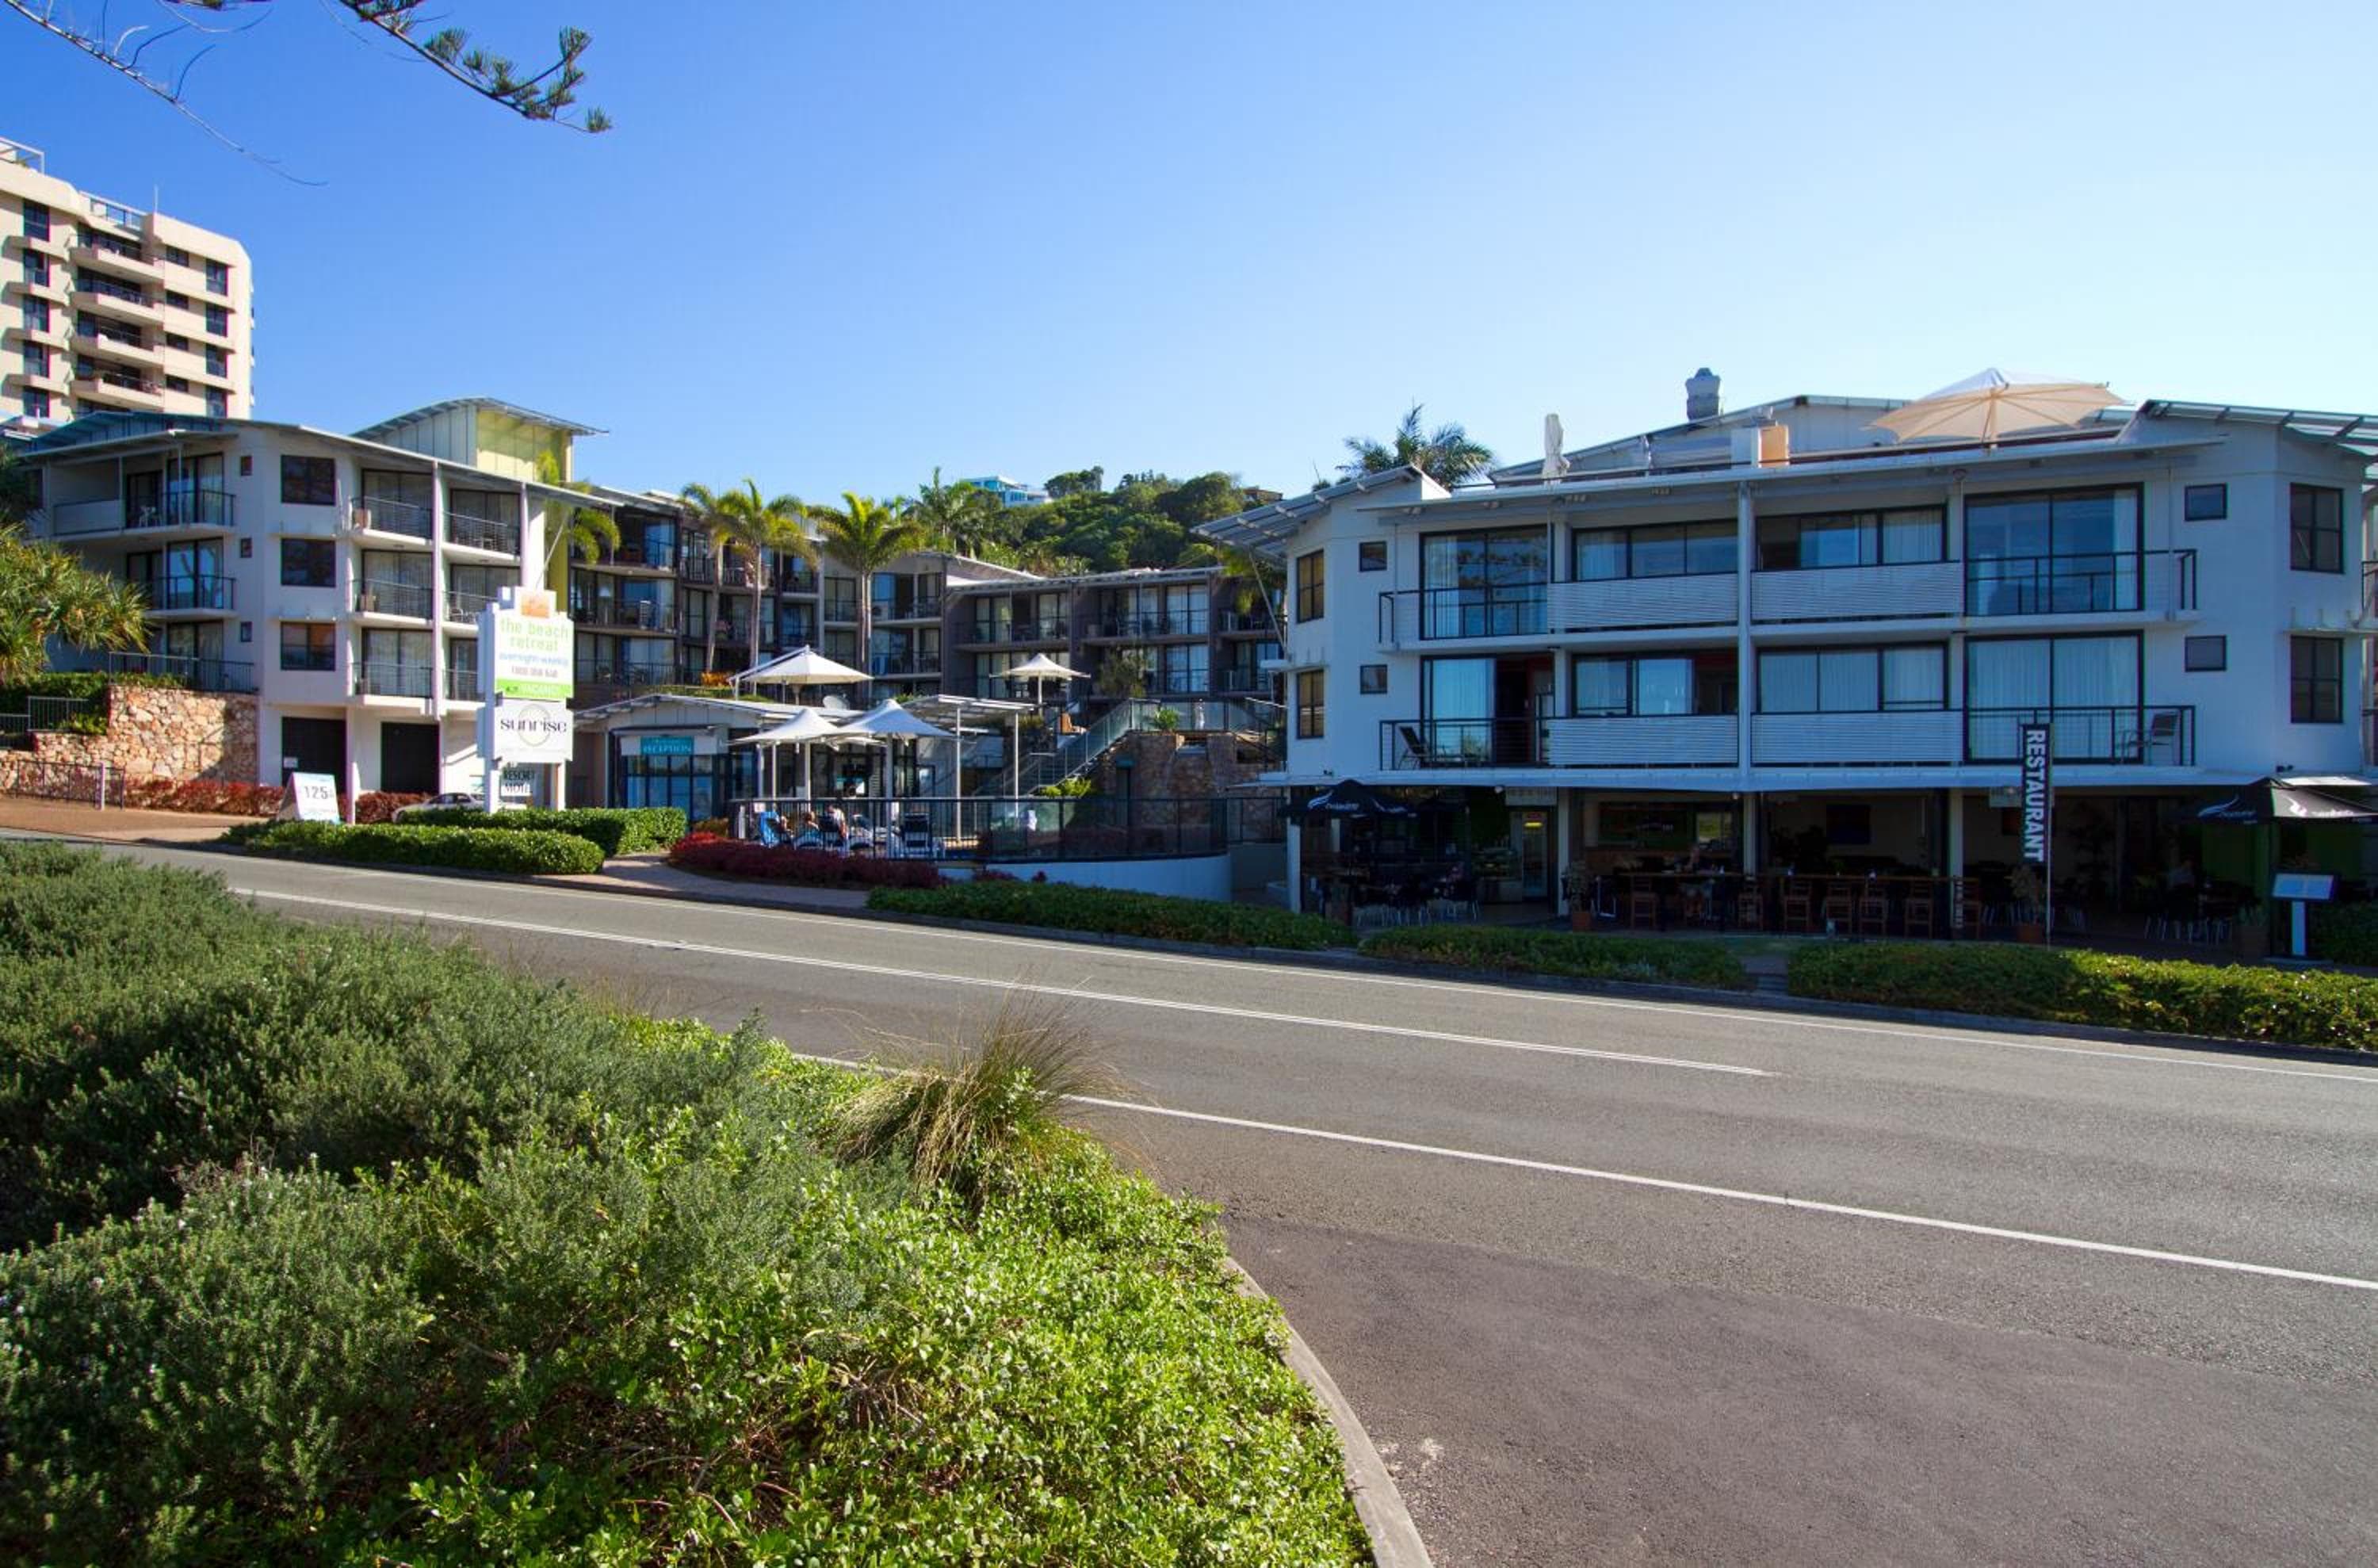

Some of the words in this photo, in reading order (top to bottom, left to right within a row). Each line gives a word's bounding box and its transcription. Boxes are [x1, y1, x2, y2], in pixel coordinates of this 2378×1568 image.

[500, 618, 522, 633] the
[529, 622, 569, 639] beach
[510, 637, 558, 651] retreat
[500, 719, 567, 732] sunrise
[2025, 730, 2045, 862] RESTAURANT
